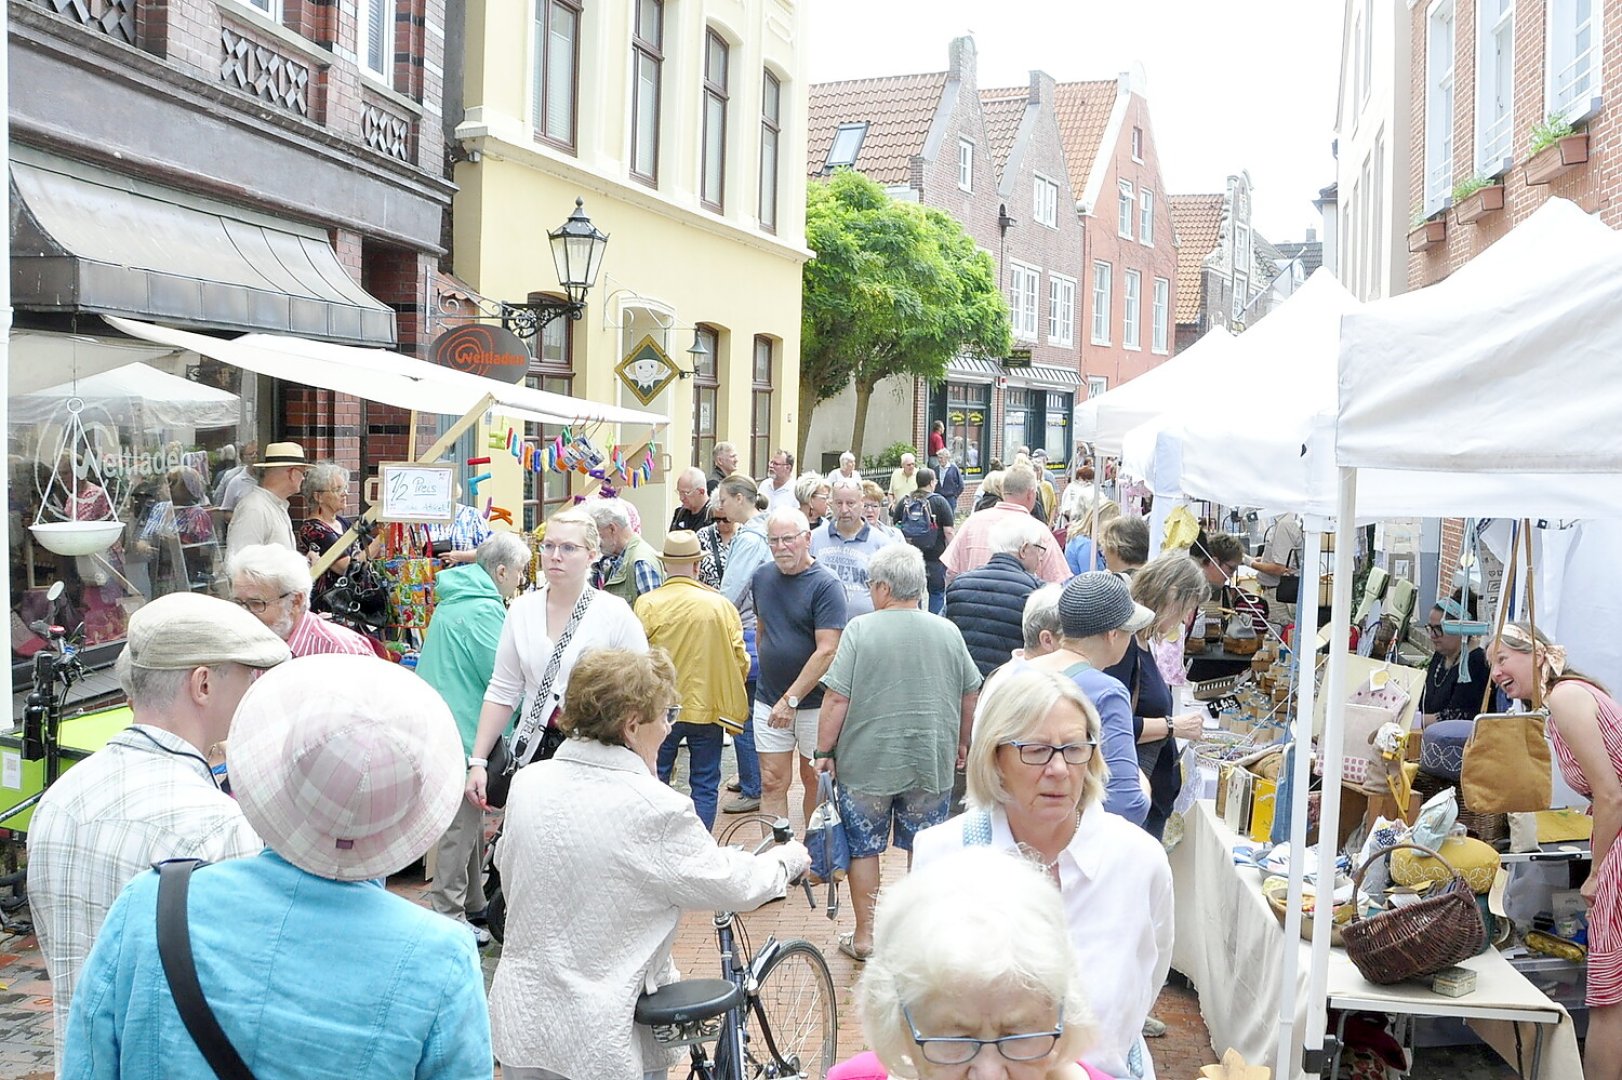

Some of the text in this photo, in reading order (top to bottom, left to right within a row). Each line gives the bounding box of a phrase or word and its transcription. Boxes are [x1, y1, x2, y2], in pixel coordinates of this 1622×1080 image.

[456, 350, 526, 366] Weltladen
[390, 471, 437, 502] 1/2 Preis
